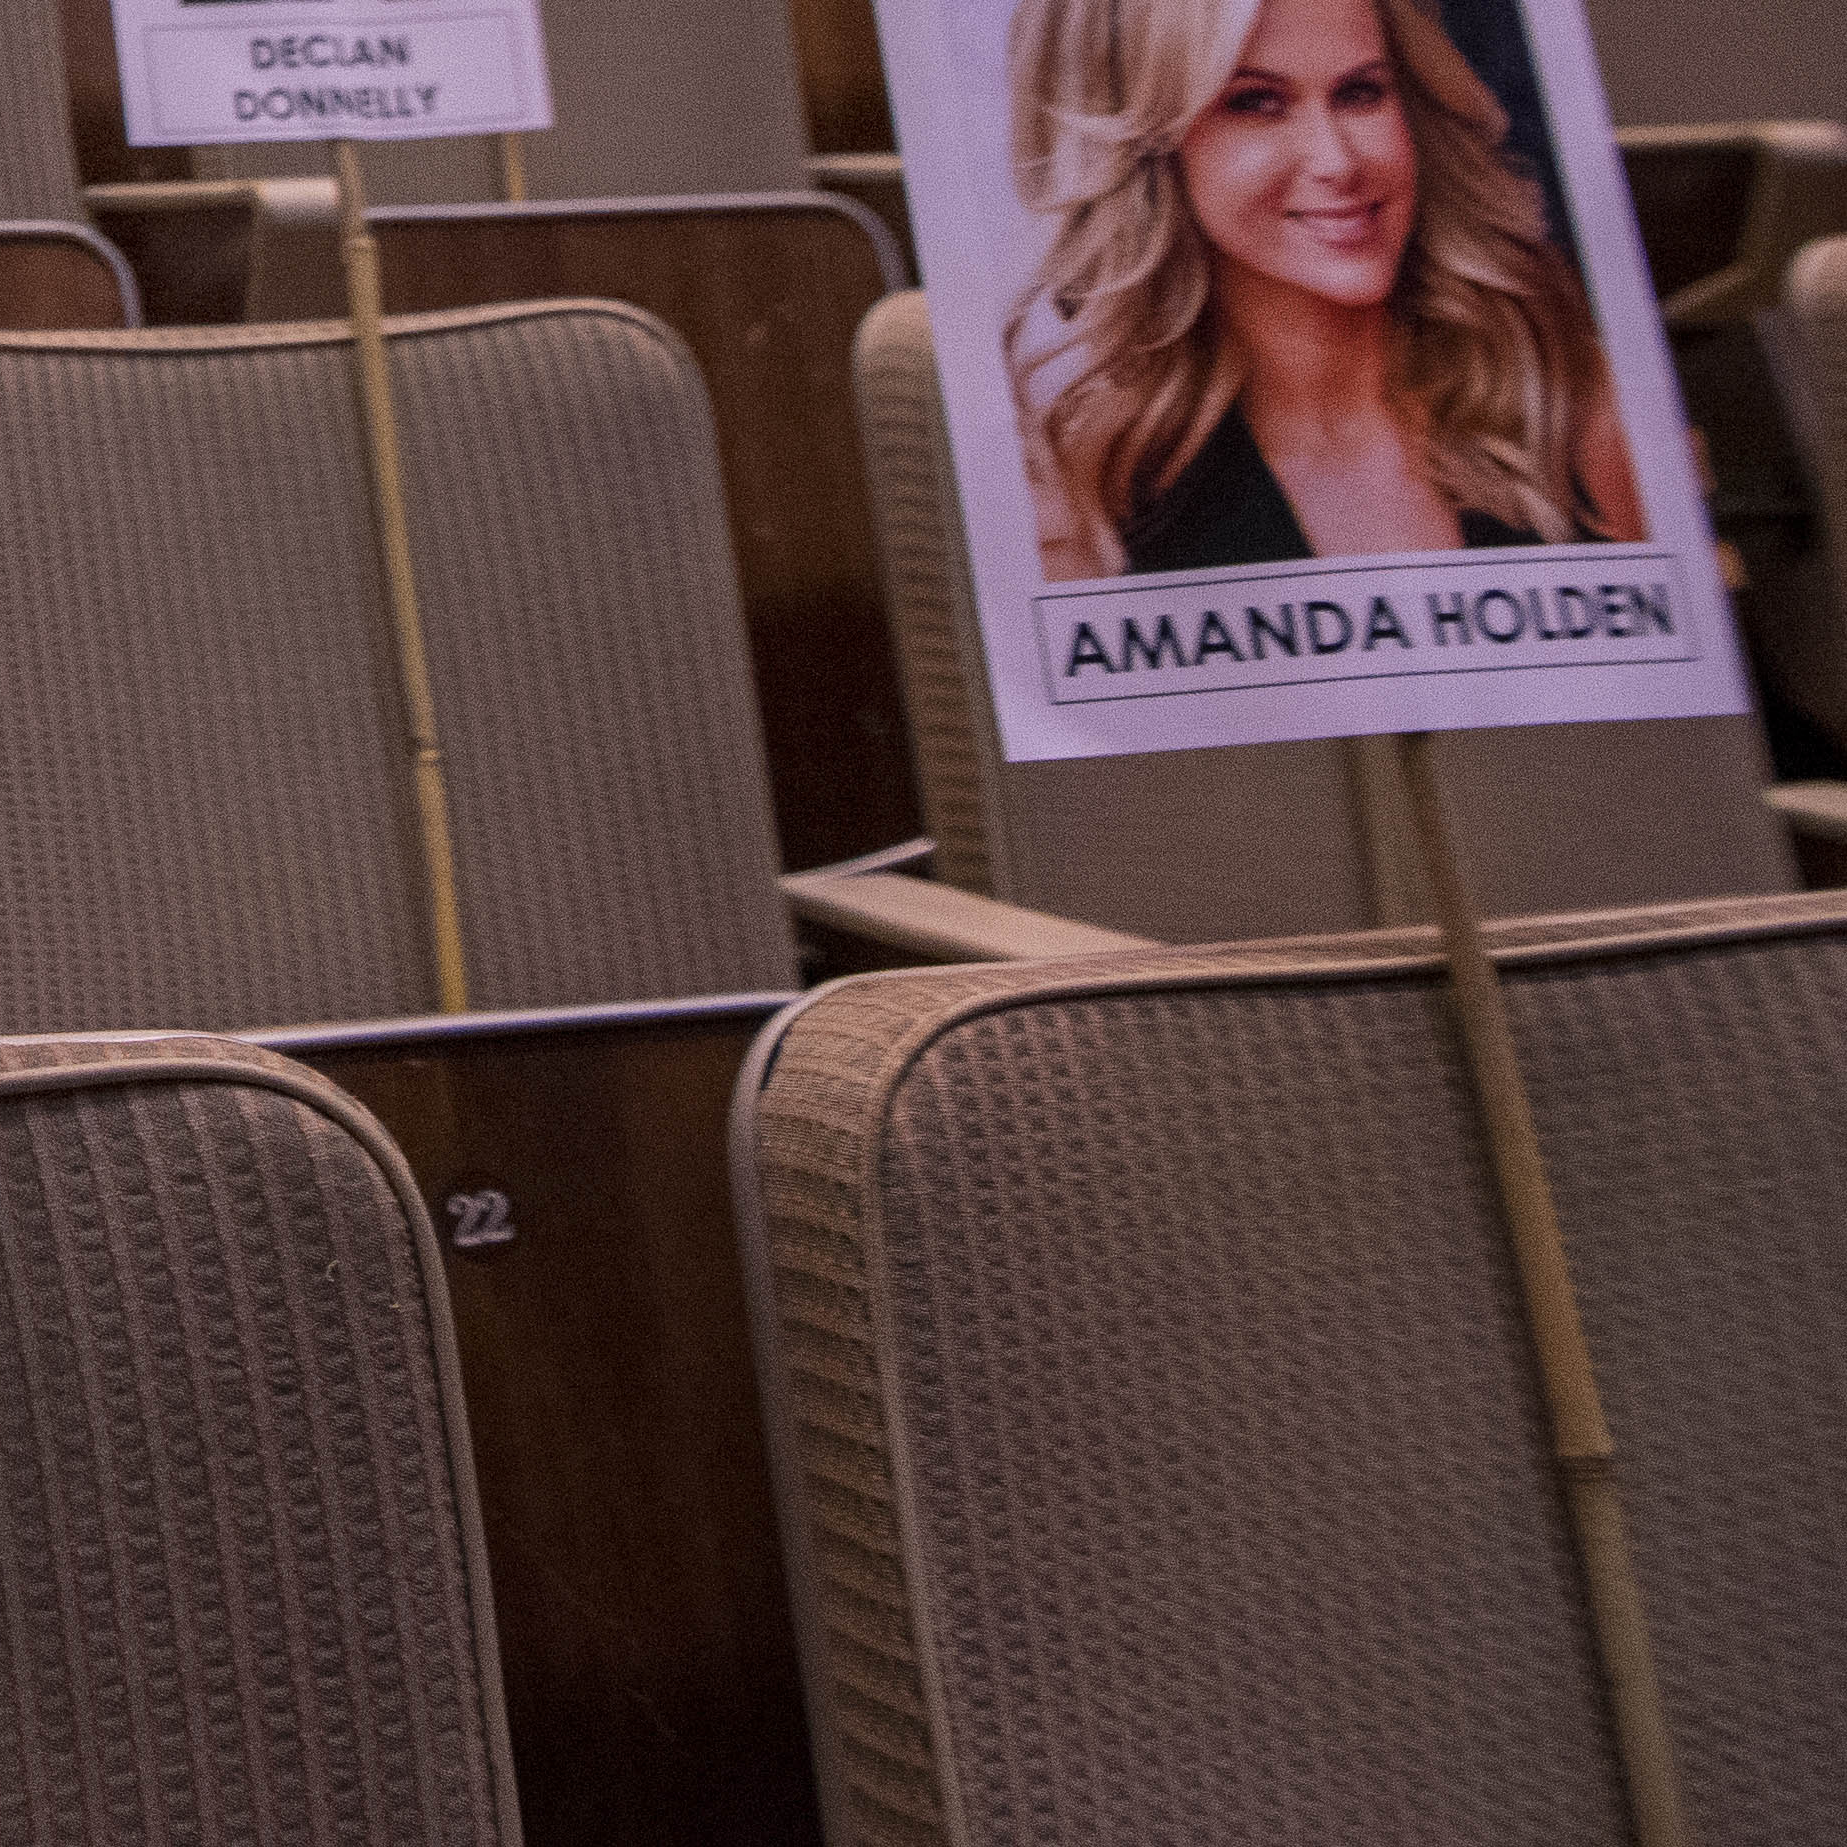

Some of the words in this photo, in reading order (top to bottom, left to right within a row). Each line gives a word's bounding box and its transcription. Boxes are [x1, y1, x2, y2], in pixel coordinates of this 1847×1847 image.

[250, 34, 410, 70] DECLAN
[233, 85, 439, 122] DONNELLY
[1064, 594, 1411, 678] AMANDA
[1427, 582, 1679, 646] HOLDEN
[446, 1189, 516, 1247] 22
